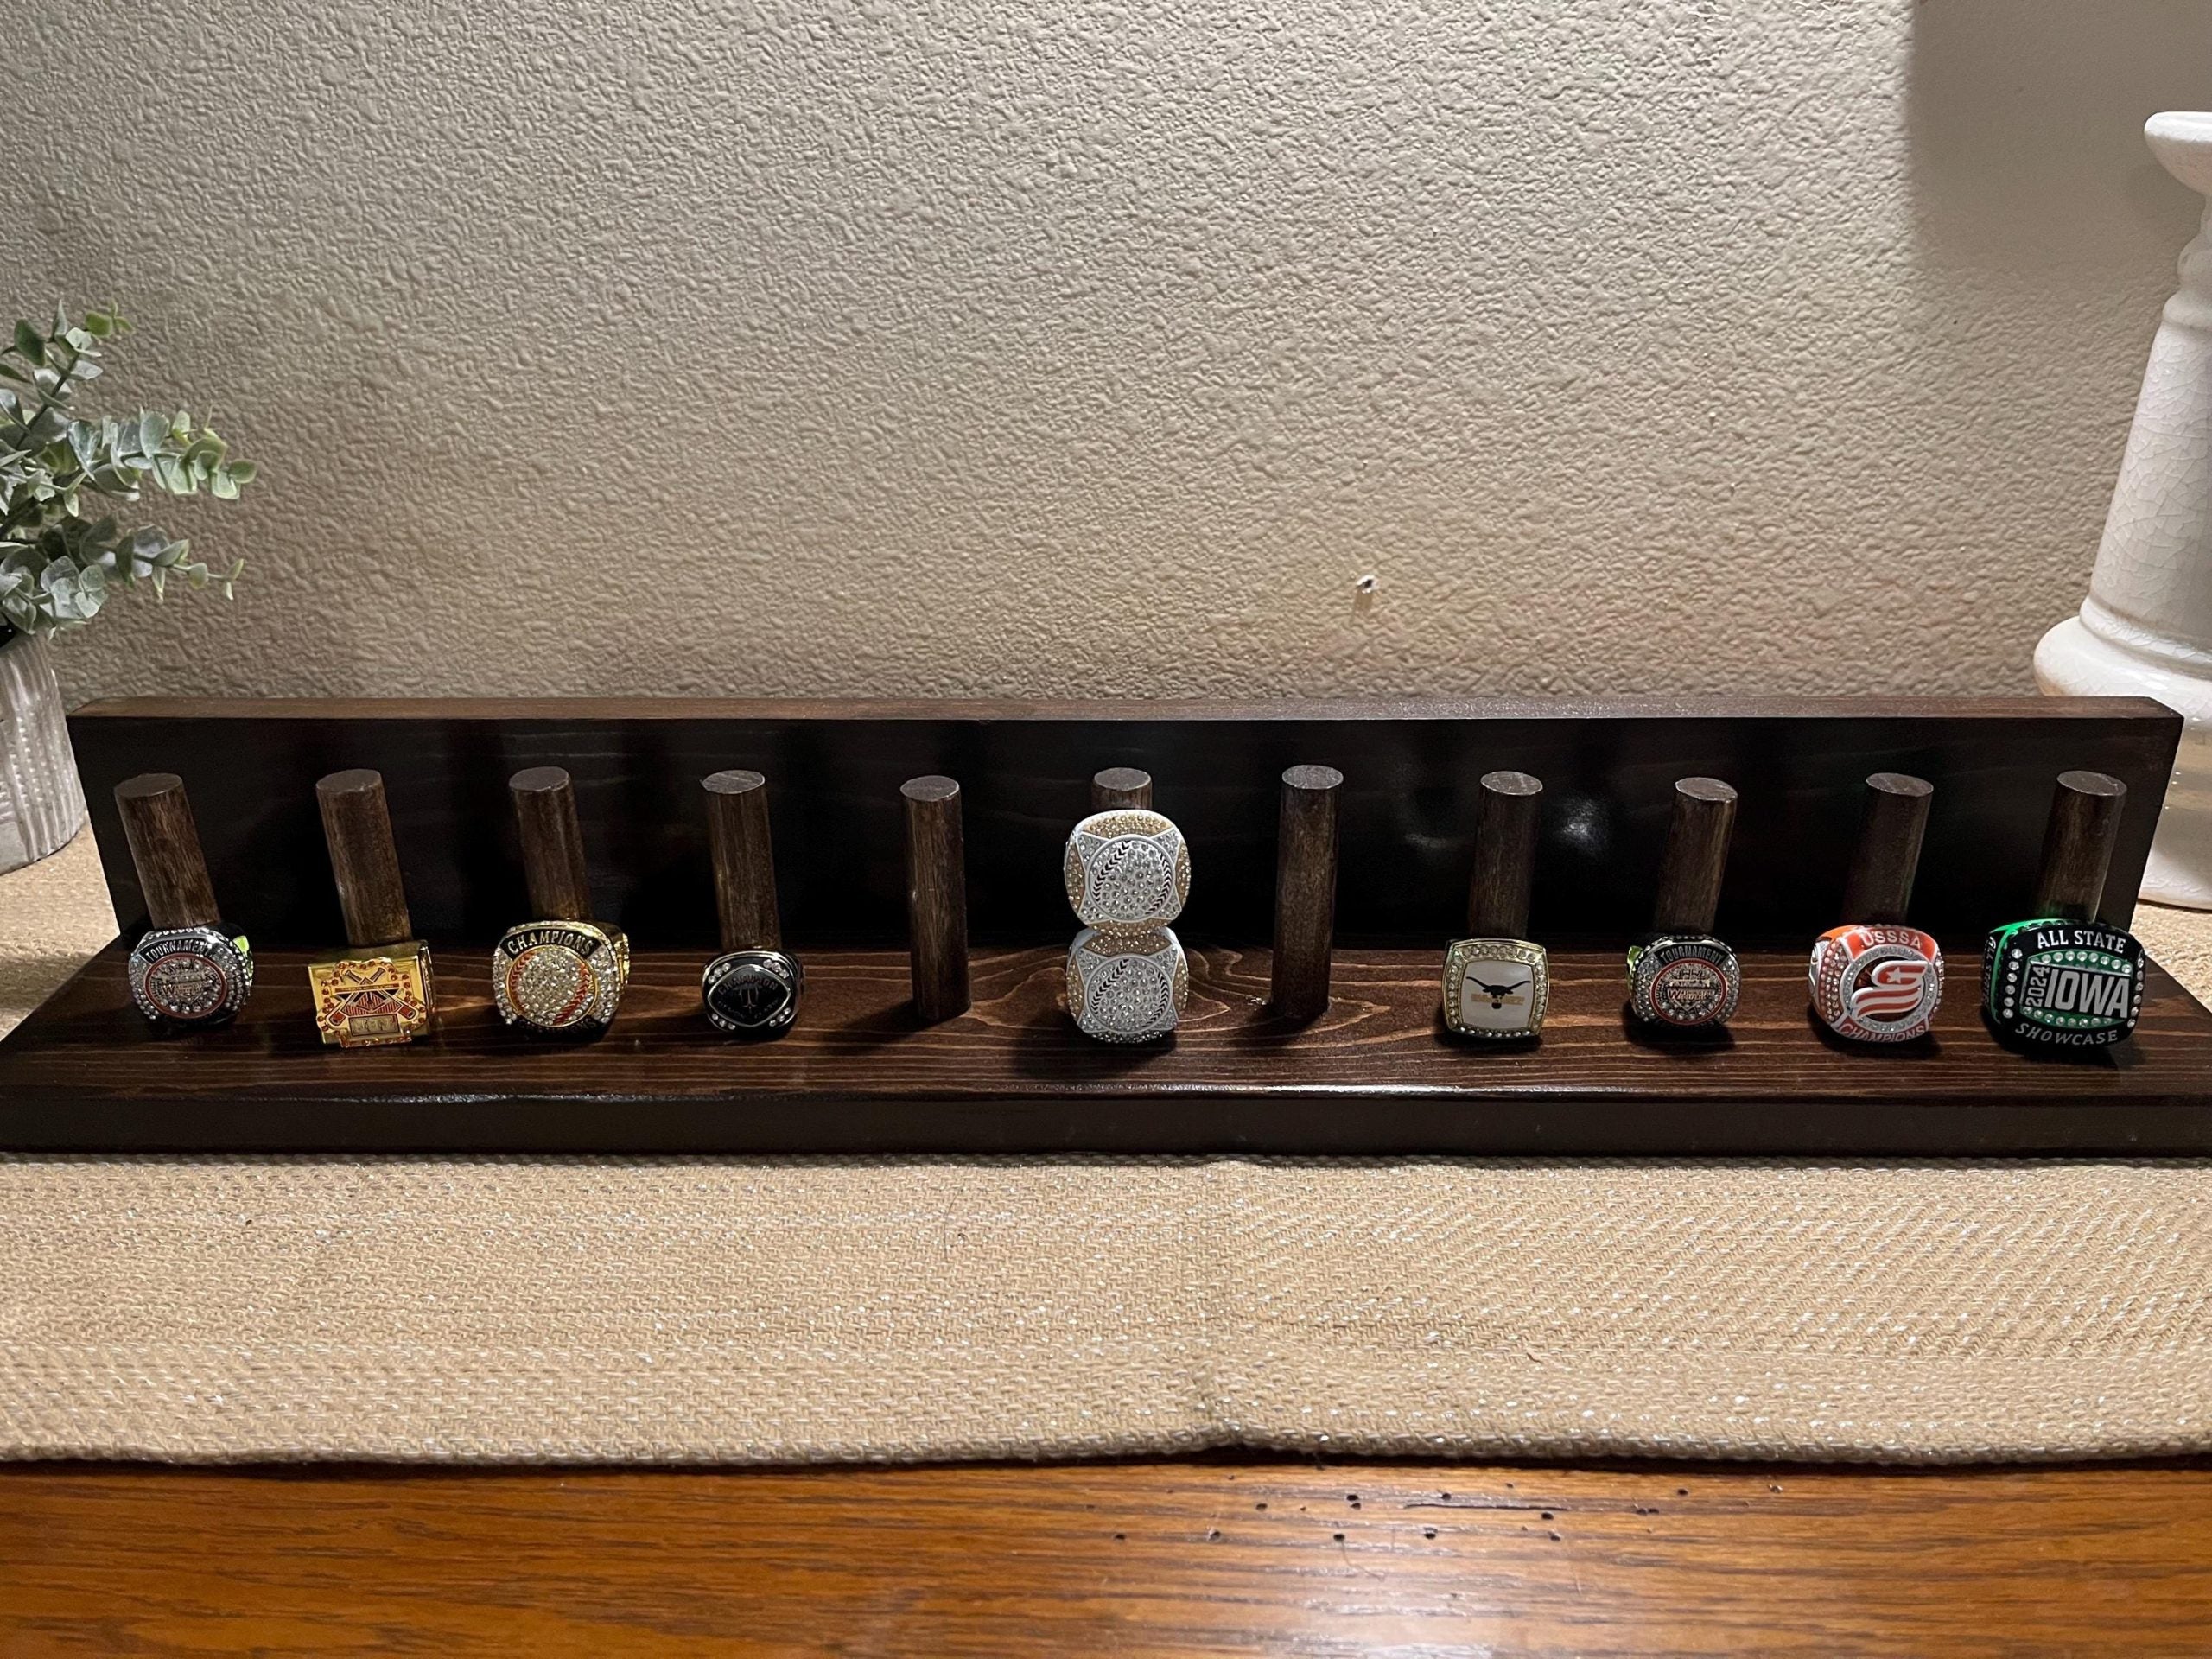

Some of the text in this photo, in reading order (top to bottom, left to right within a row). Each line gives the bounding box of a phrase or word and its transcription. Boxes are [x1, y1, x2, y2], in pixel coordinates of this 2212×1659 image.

[507, 930, 594, 955] CHAMPIONS
[1858, 929, 1922, 949] USSSA
[2037, 930, 2126, 954] ALL STATE
[1660, 944, 1724, 964] TOURNAMENT
[2025, 965, 2130, 1018] 2024 IOWA
[1839, 1023, 1926, 1043] CHAMPIONS
[2015, 1022, 2118, 1046] SHOWCASE
